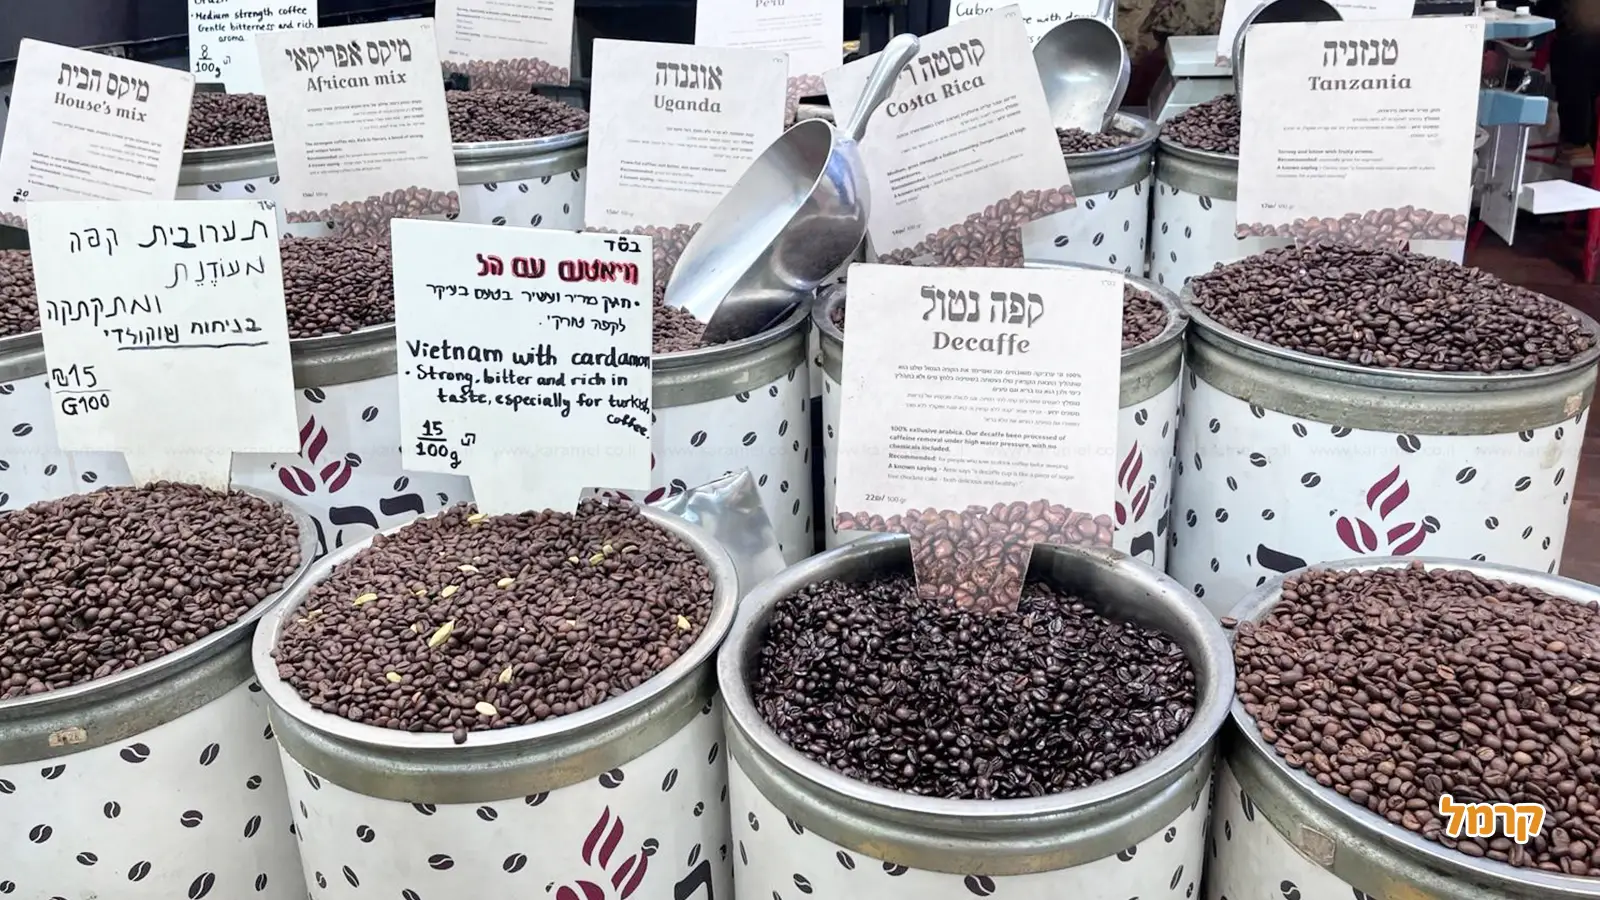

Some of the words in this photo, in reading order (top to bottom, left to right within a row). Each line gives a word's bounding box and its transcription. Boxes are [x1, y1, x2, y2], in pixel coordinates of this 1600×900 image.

[196, 10, 229, 20] Medium
[235, 8, 273, 22] strength
[278, 6, 307, 15] coffee
[198, 23, 226, 32] Gentle
[230, 22, 275, 31] bitterness
[278, 21, 294, 29] and
[297, 19, 314, 29] rich
[201, 44, 209, 58] 8
[285, 40, 363, 72] אפריקאי
[366, 37, 412, 67] מיקס
[917, 38, 986, 81] קוסטה
[1323, 38, 1399, 67] טנזניה
[57, 62, 102, 92] הבית
[195, 62, 221, 78] 100g
[307, 73, 370, 93] African
[375, 70, 407, 87] mix
[655, 61, 723, 90] אוגנדה
[106, 72, 150, 102] מיקס
[1308, 73, 1412, 91] Tanzania
[54, 92, 112, 115] House's
[116, 106, 147, 123] mix
[654, 95, 722, 113] Uganda
[886, 93, 938, 118] Costa
[943, 75, 986, 99] Rica
[69, 228, 118, 256] קפה
[477, 253, 505, 276] הל
[512, 256, 546, 278] עם
[426, 283, 470, 300] בעיקר
[474, 287, 513, 301] בטעם
[521, 291, 560, 304] ועשיר
[564, 294, 598, 305] מריר
[920, 284, 980, 322] נטול
[990, 291, 1045, 328] קפה
[104, 324, 179, 345] שוקולדי
[191, 317, 262, 334] בניחוח
[591, 317, 626, 336] לקפה
[406, 339, 503, 363] Vietnam
[512, 343, 557, 366] with
[933, 331, 1030, 356] Decaffe
[484, 368, 532, 386] bitter
[537, 372, 566, 387] and
[571, 372, 606, 387] rich
[611, 373, 628, 386] in
[62, 393, 110, 415] G100
[495, 392, 571, 417] especially
[576, 392, 603, 408] for
[422, 419, 443, 436] 15
[415, 441, 462, 469] 100g
